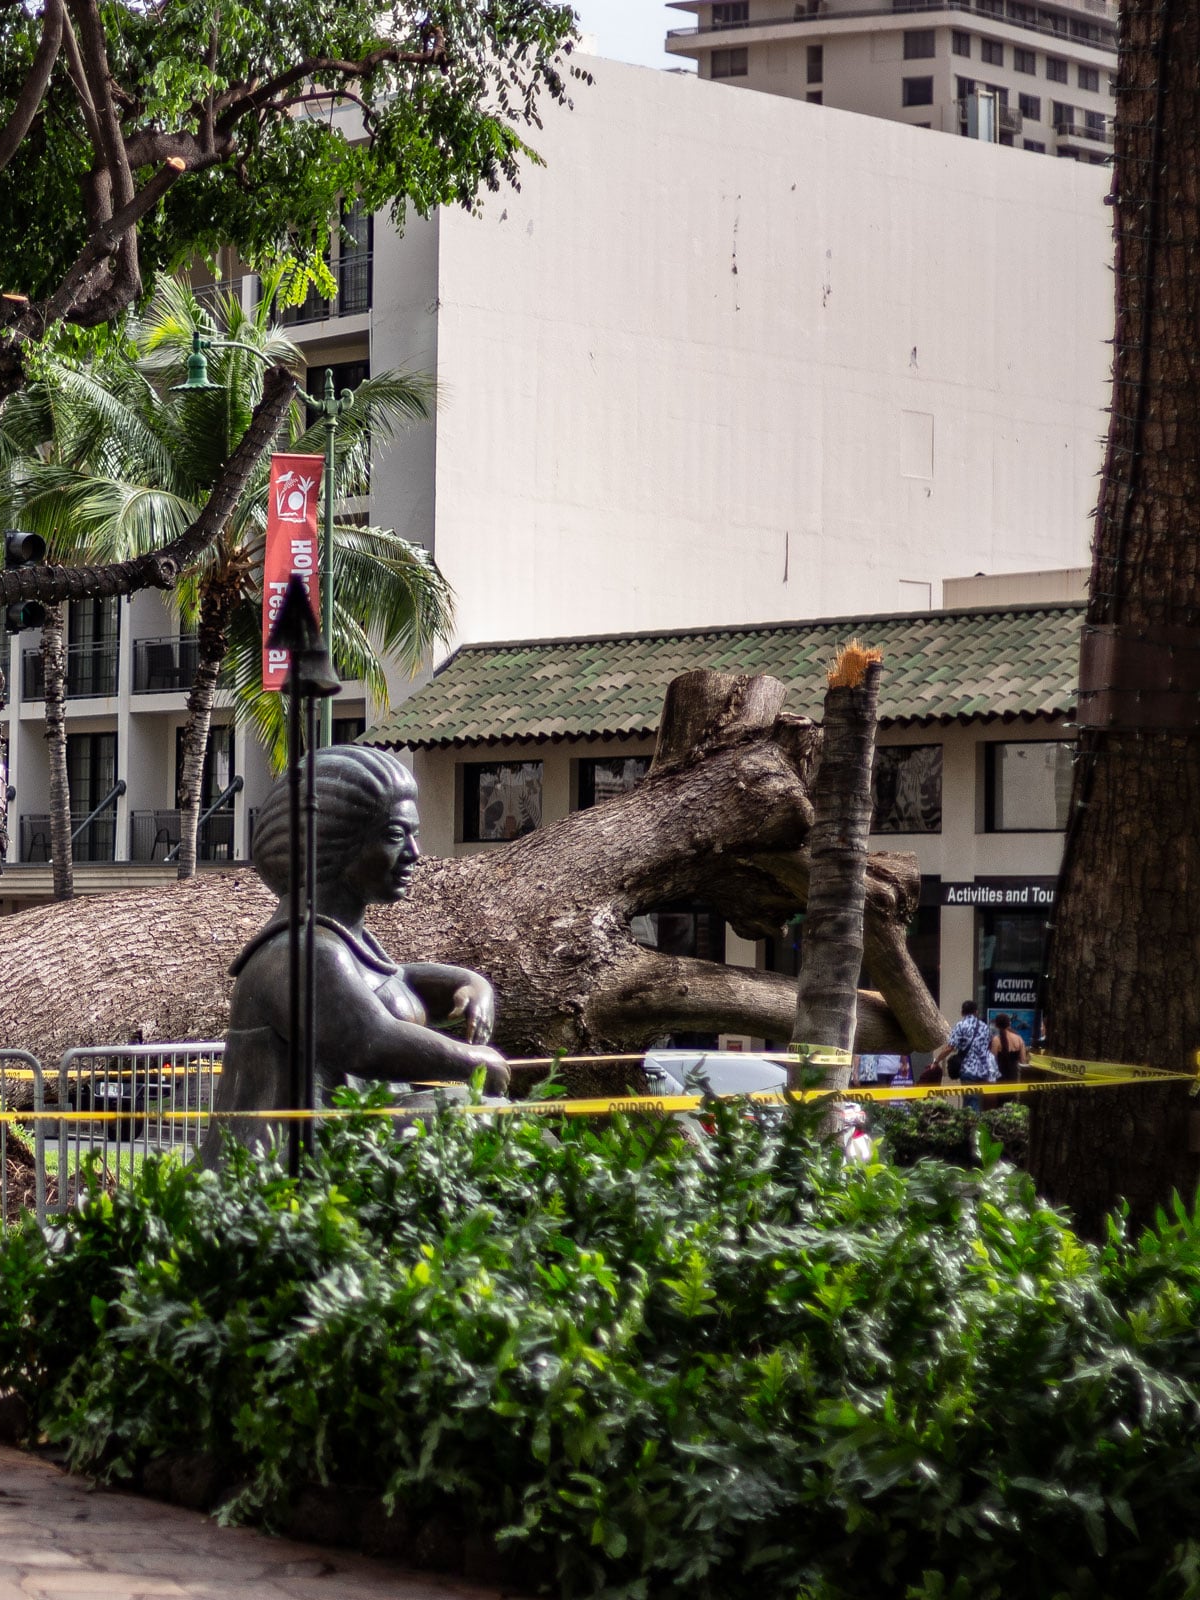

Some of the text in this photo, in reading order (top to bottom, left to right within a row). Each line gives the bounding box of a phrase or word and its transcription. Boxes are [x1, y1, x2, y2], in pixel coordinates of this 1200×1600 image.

[947, 886, 1054, 903] Activities and Tou
[996, 979, 1034, 990] ACTIVITY
[994, 992, 1037, 1003] PACKAGES
